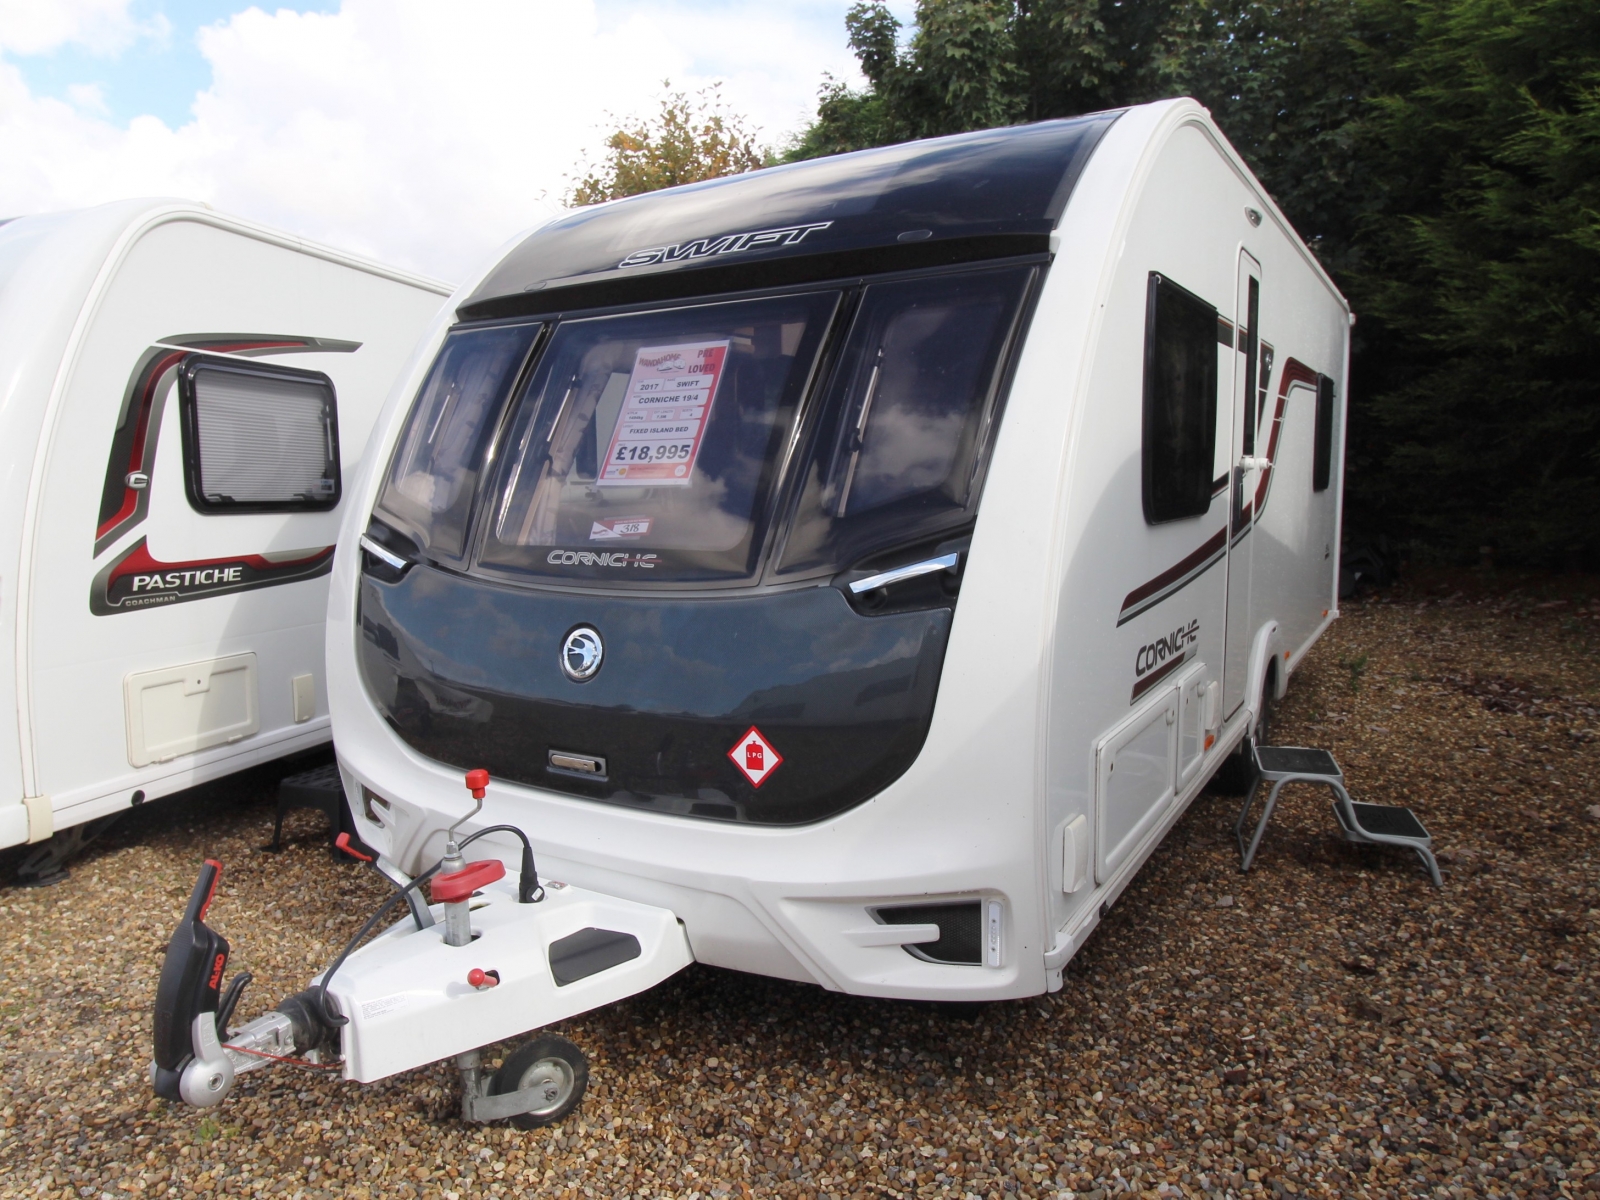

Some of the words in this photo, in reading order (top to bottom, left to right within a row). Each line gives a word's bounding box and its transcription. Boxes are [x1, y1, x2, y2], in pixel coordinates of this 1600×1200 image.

[618, 221, 834, 269] SWIFT
[697, 349, 714, 359] PRE
[688, 364, 716, 373] LOVED
[638, 395, 681, 404] CORNICHE
[616, 444, 690, 463] £18,995
[547, 550, 660, 568] CORNICHE
[132, 567, 242, 591] PASTICHE
[125, 596, 176, 606] COACHMAN
[1135, 618, 1199, 677] CORNICHE
[209, 953, 225, 989] AL-KO
